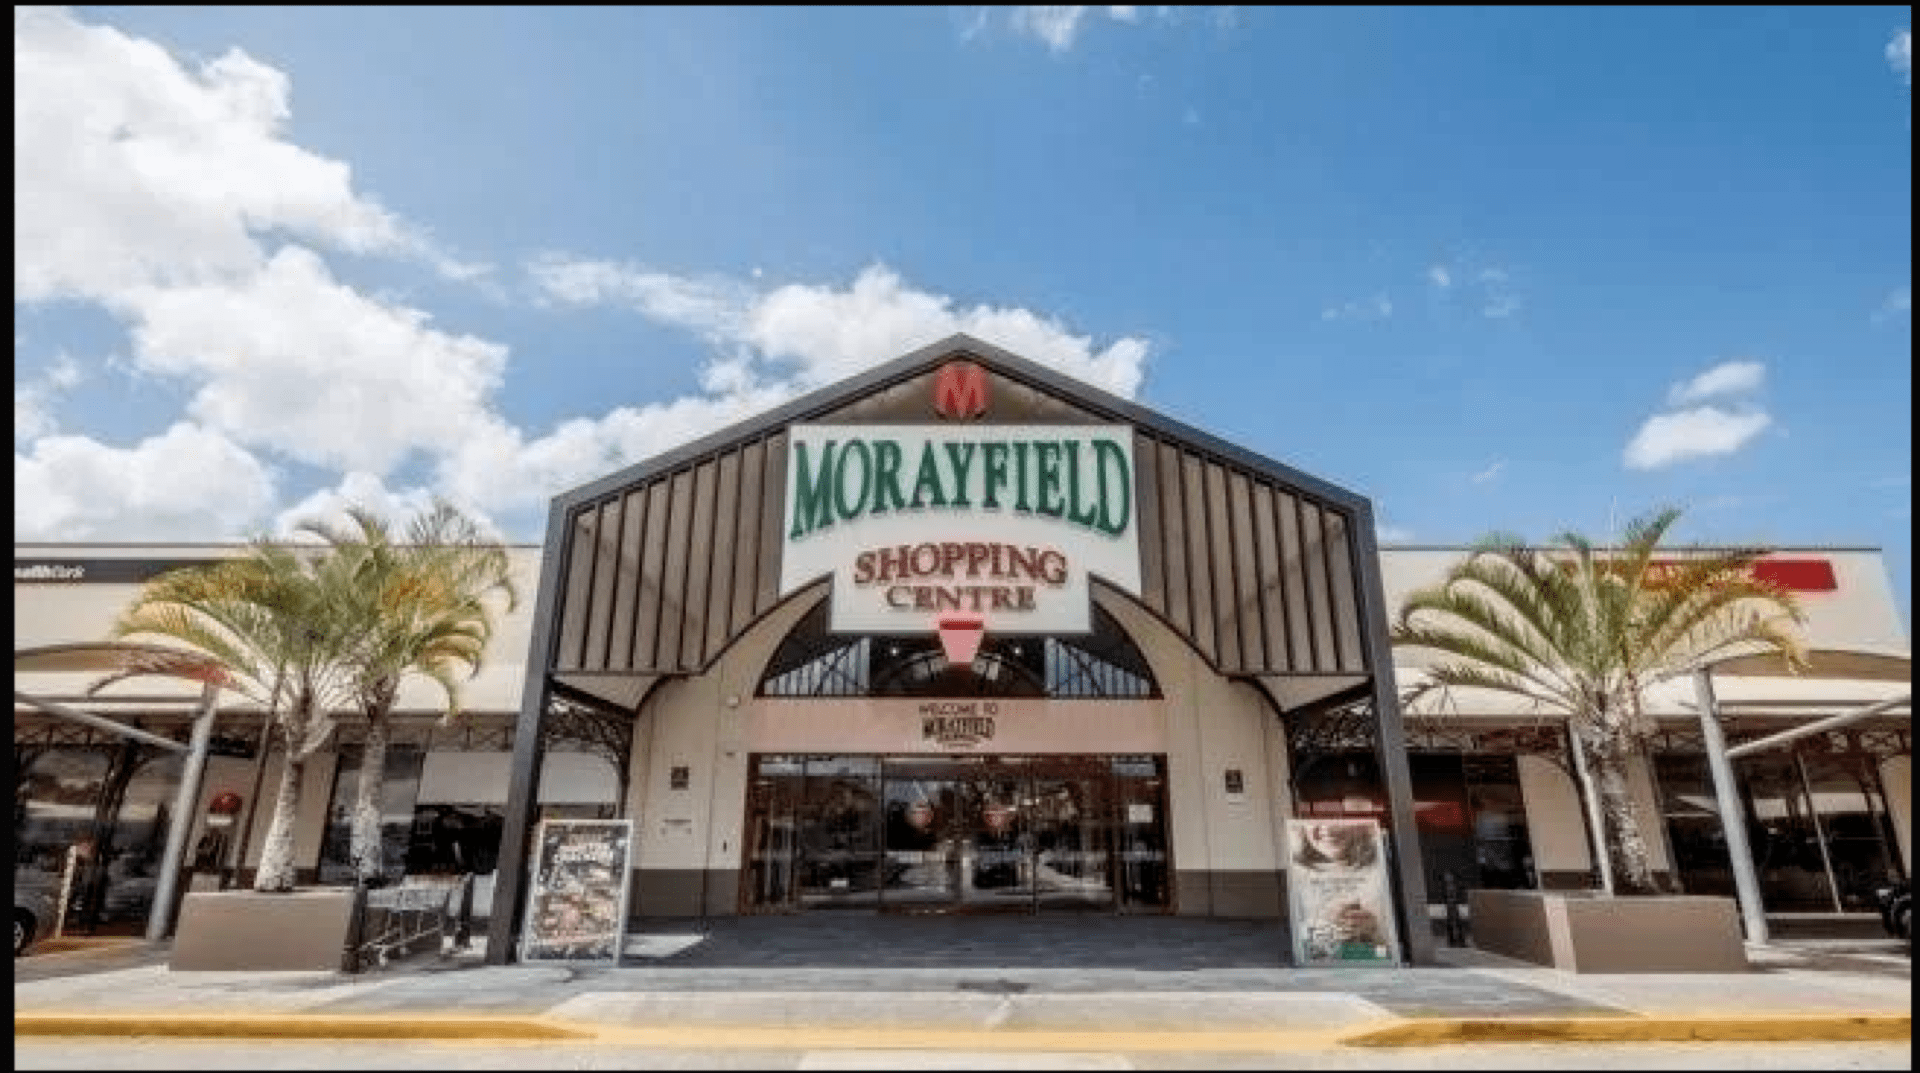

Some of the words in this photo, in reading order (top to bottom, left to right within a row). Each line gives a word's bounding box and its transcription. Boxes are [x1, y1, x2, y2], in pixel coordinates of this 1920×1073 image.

[789, 438, 1131, 541] MORAYFIELD
[853, 542, 1069, 586] SHOPPING
[885, 585, 1037, 613] CENTRE
